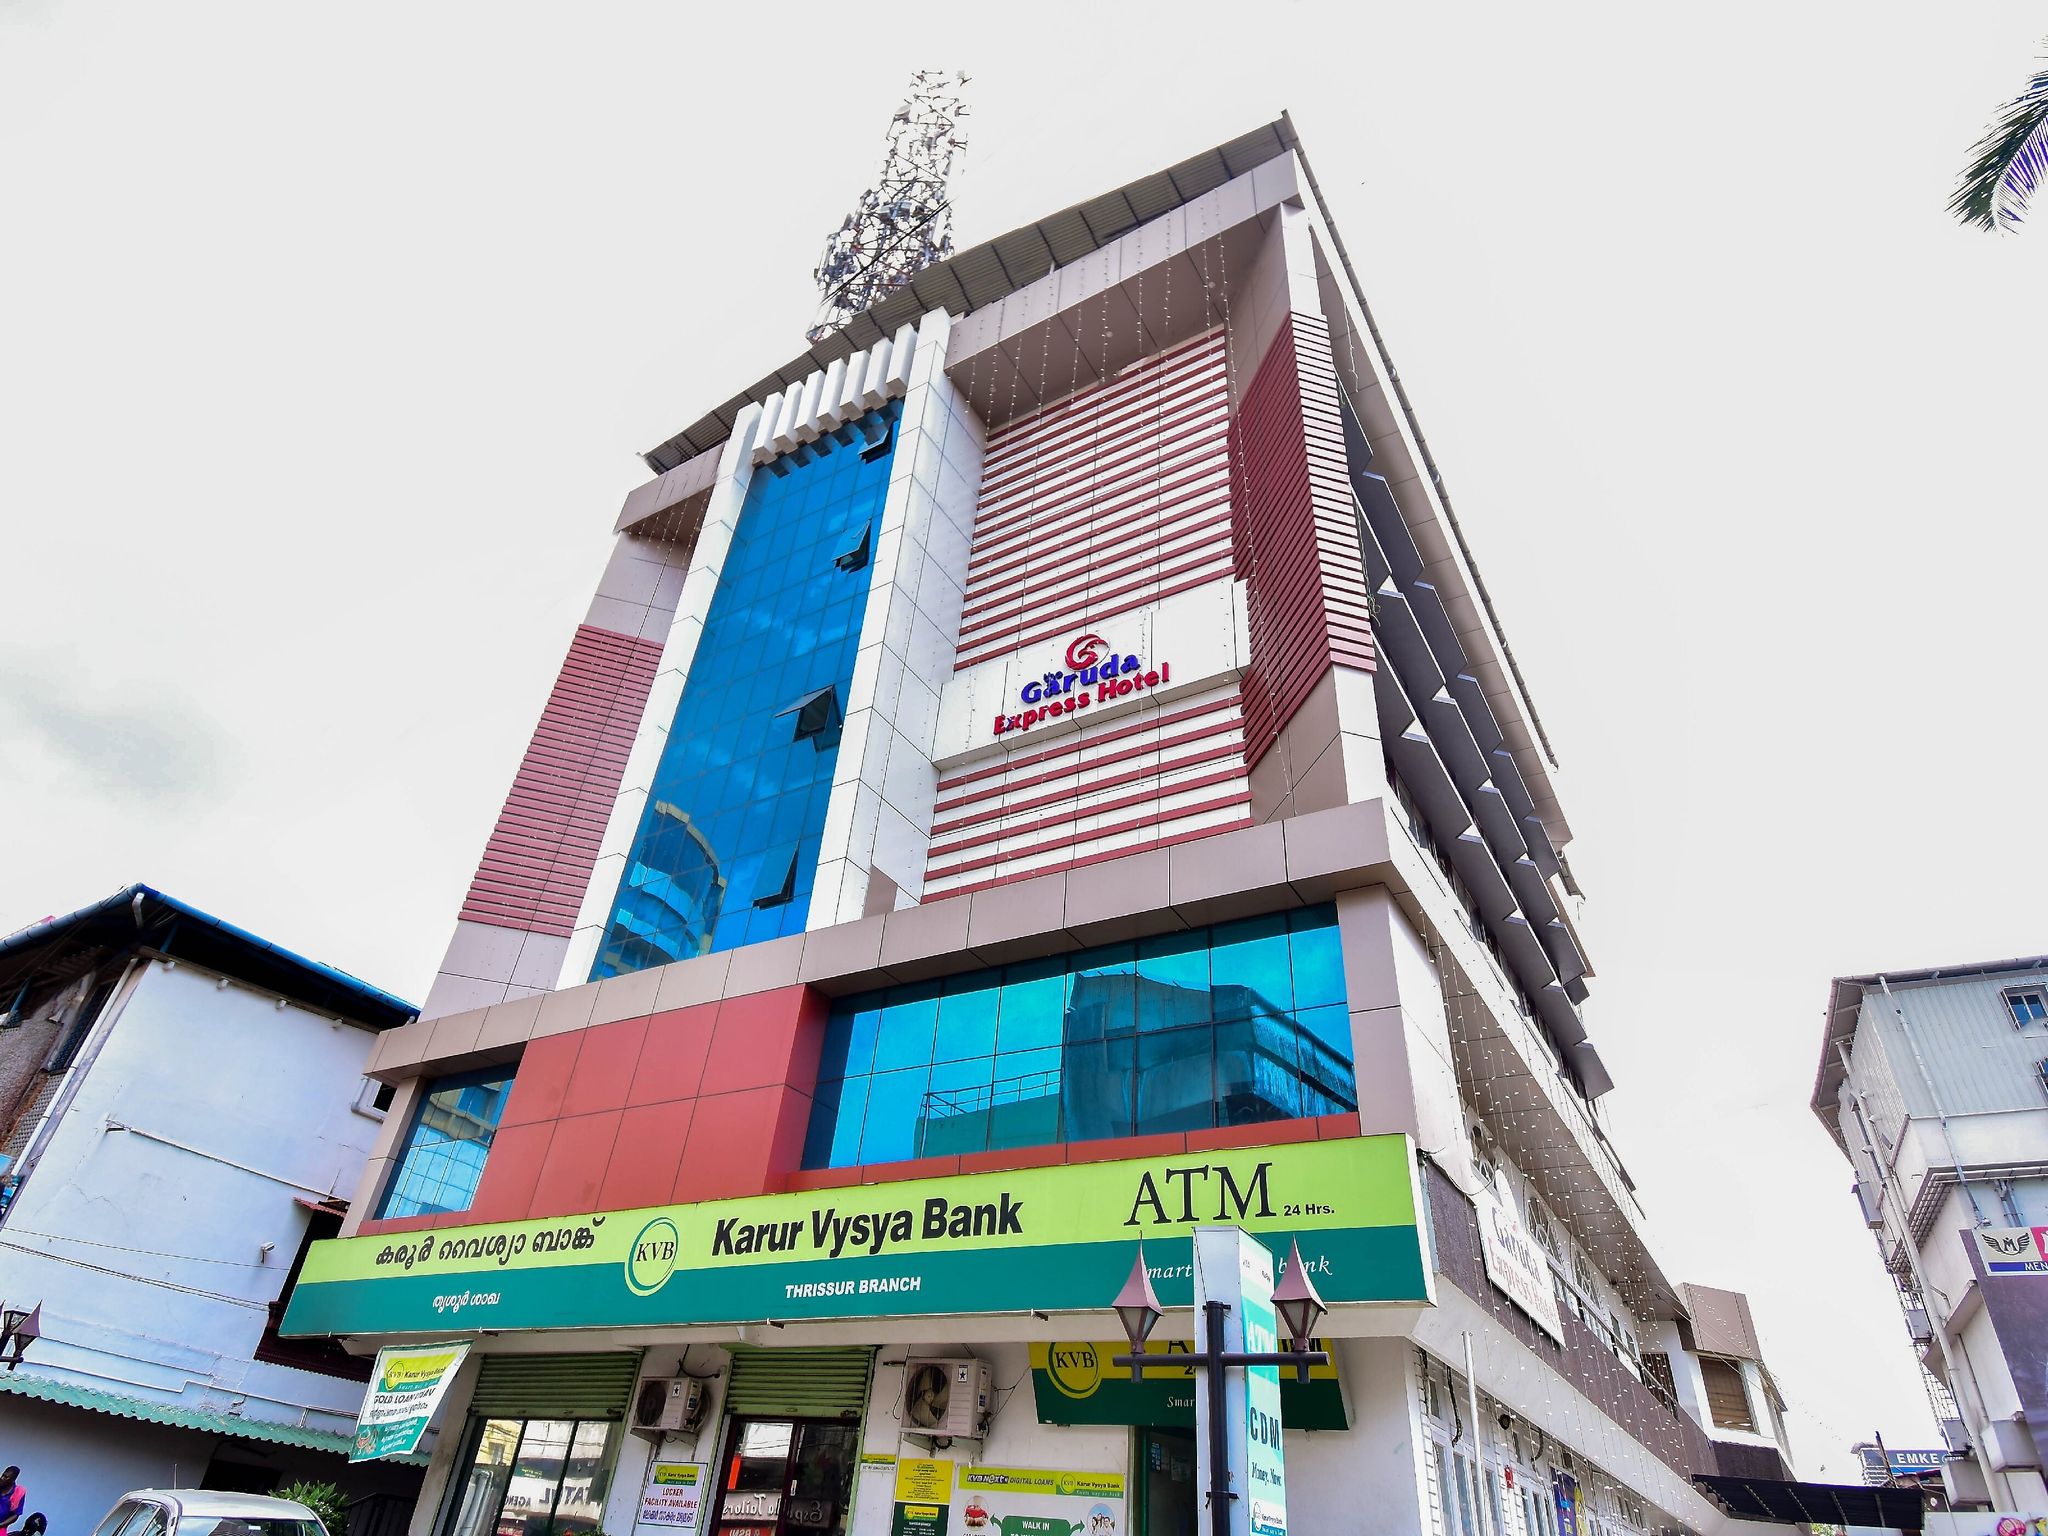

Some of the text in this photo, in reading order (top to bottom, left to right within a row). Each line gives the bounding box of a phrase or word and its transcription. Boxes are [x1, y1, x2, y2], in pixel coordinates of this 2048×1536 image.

[1020, 653, 1141, 704] Garuda
[993, 661, 1170, 736] Express Hotel
[1123, 1162, 1335, 1226] ATM 24 Hrs.
[711, 1192, 1024, 1259] Karur Vysya Bank
[635, 1240, 675, 1263] KVB
[1146, 1262, 1193, 1279] mart
[1278, 1255, 1334, 1276] bnk
[784, 1276, 921, 1299] THRISSUR BRANCH
[1054, 1351, 1095, 1369] KVB
[1184, 1365, 1196, 1376] 2
[1249, 1406, 1281, 1451] CDM
[1896, 1453, 1940, 1464] EMKE
[662, 1487, 684, 1497] LOCKER
[1010, 1477, 1033, 1485] DIGITAL
[1034, 1478, 1054, 1486] LOANS
[644, 1497, 698, 1509] FACILITY AVAILABLE
[1022, 1520, 1050, 1531] WALK IN
